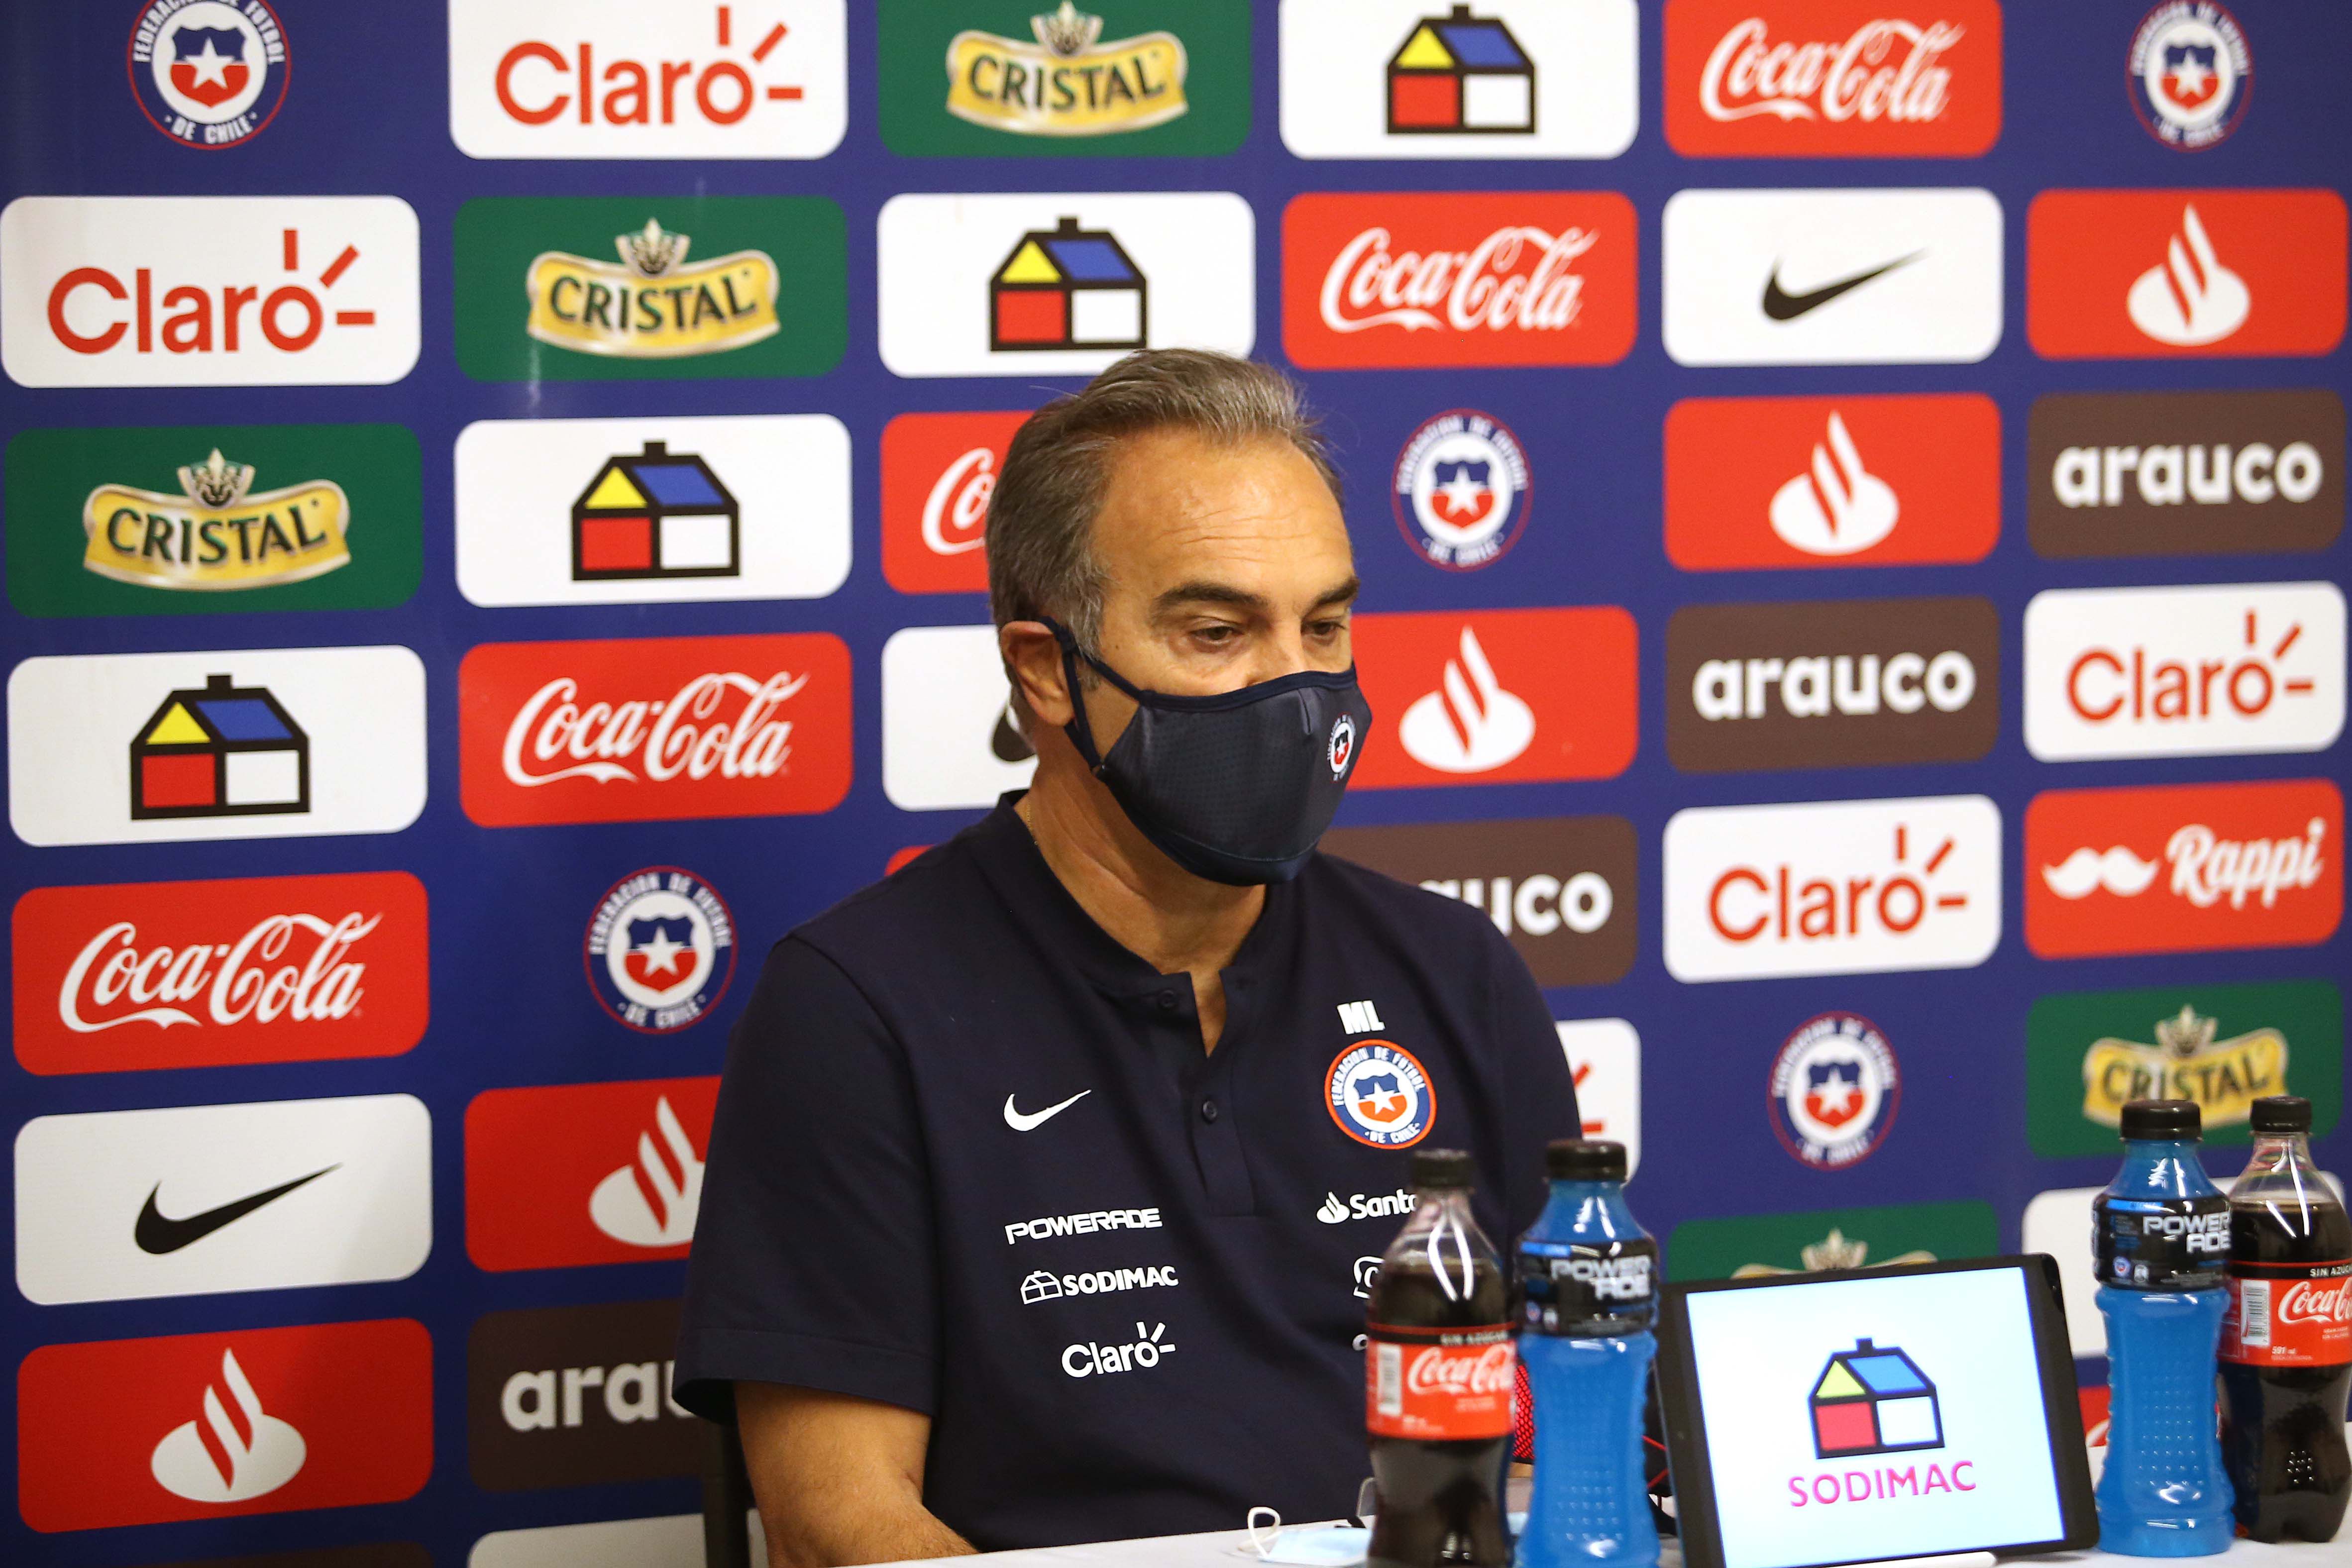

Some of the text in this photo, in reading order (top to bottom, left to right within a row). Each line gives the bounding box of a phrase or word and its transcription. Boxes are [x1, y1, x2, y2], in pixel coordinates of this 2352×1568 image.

[496, 41, 753, 125] Claro
[969, 55, 1167, 110] CRISTAL
[1700, 19, 1965, 121] Coca-Cola
[172, 115, 253, 144] DE CHILE
[550, 275, 756, 331] CRISTAL
[1320, 226, 1599, 332] Coca-Cola
[48, 267, 322, 354] Claro
[2051, 441, 2324, 509] arauco
[107, 505, 326, 563] CRISTAL
[1691, 650, 1977, 722] arauco
[2068, 650, 2273, 723] Claro
[503, 672, 806, 786] Coca-Cola
[2165, 816, 2326, 910] Rappi
[1710, 868, 1925, 942] Claro
[59, 912, 383, 1033] Coca-Cola
[1337, 999, 1385, 1035] ML
[1374, 1046, 1390, 1060] DE
[1392, 1052, 1426, 1092] FUTBOL
[2101, 1051, 2269, 1104] CRISTAL
[1369, 1124, 1420, 1144] DE CHILE
[1004, 1207, 1163, 1245] POWERADE
[2143, 1212, 2231, 1235] POWER
[1062, 1265, 1179, 1296] SODIMAC
[2310, 1268, 2329, 1278] SIN
[1062, 1342, 1159, 1378] Claro
[2272, 1346, 2286, 1355] 591
[1788, 1460, 1976, 1507] SODIMAC
